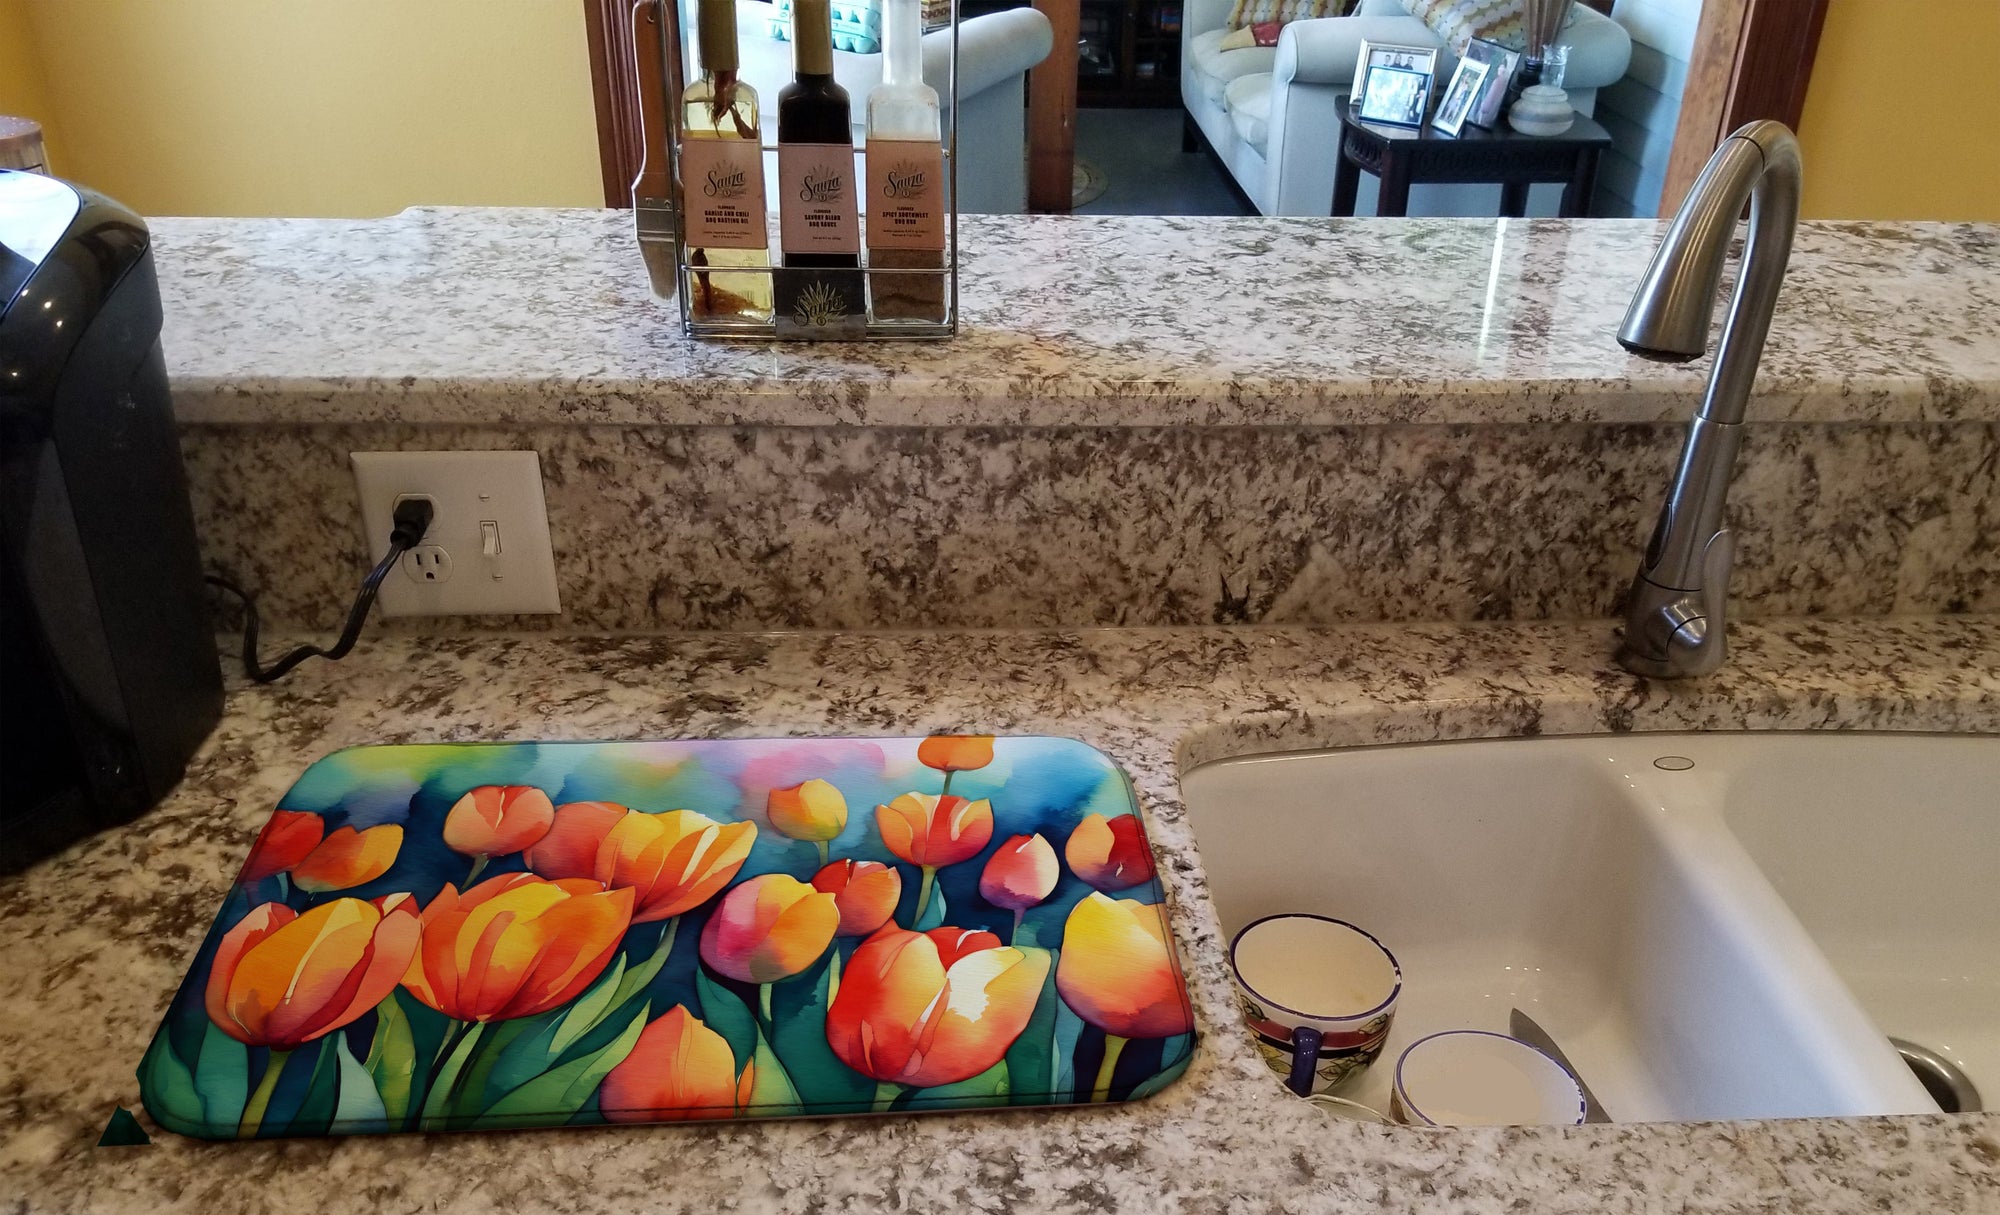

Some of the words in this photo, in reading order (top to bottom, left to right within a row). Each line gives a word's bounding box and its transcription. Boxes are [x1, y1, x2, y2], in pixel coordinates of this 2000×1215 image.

[703, 171, 745, 197] Sauza
[800, 176, 841, 202] Sauza
[884, 171, 925, 198] Sauza
